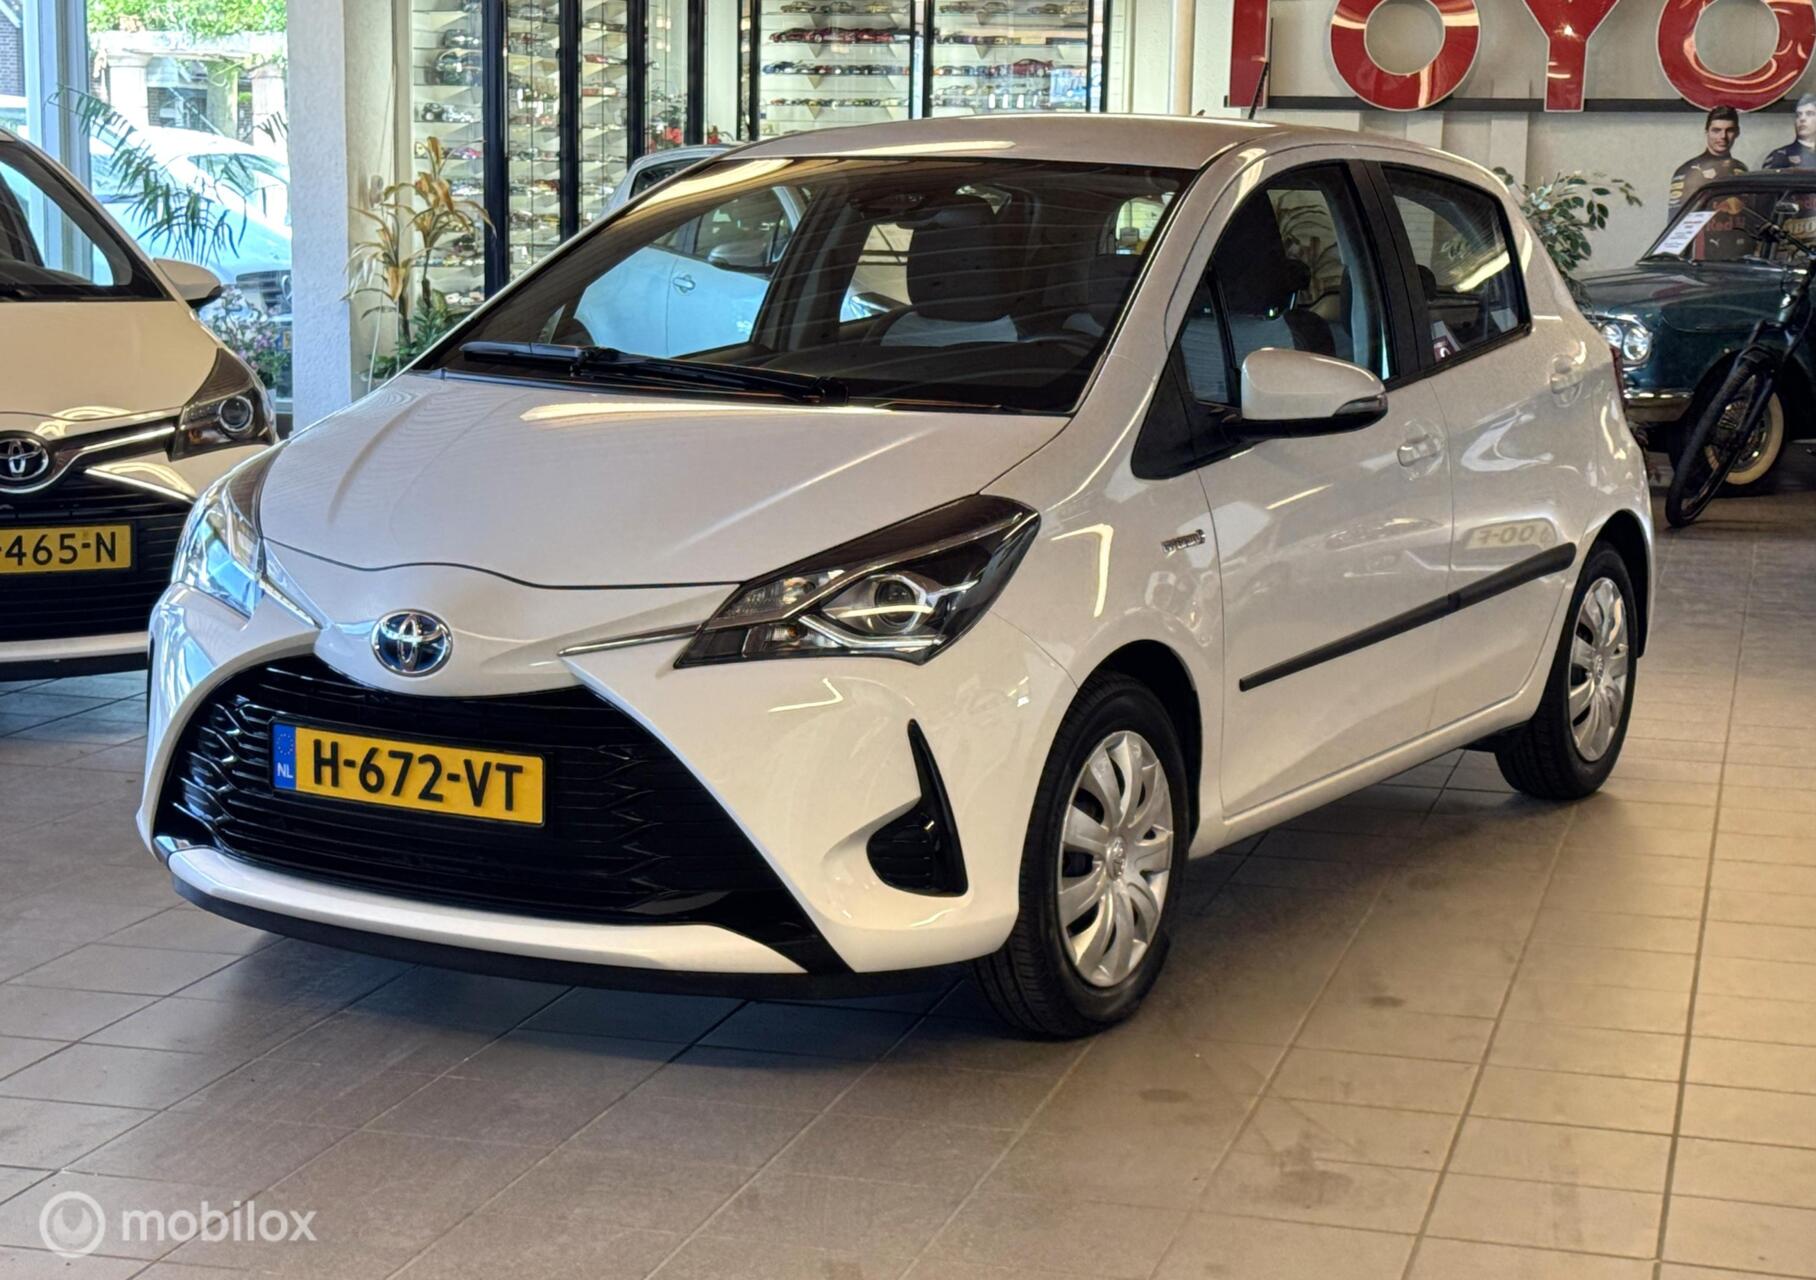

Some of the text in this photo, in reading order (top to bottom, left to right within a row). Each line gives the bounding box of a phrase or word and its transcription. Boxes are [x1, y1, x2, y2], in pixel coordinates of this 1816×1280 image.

[0, 531, 116, 566] 465-N
[277, 762, 294, 779] NL
[313, 738, 524, 812] H-672-VT
